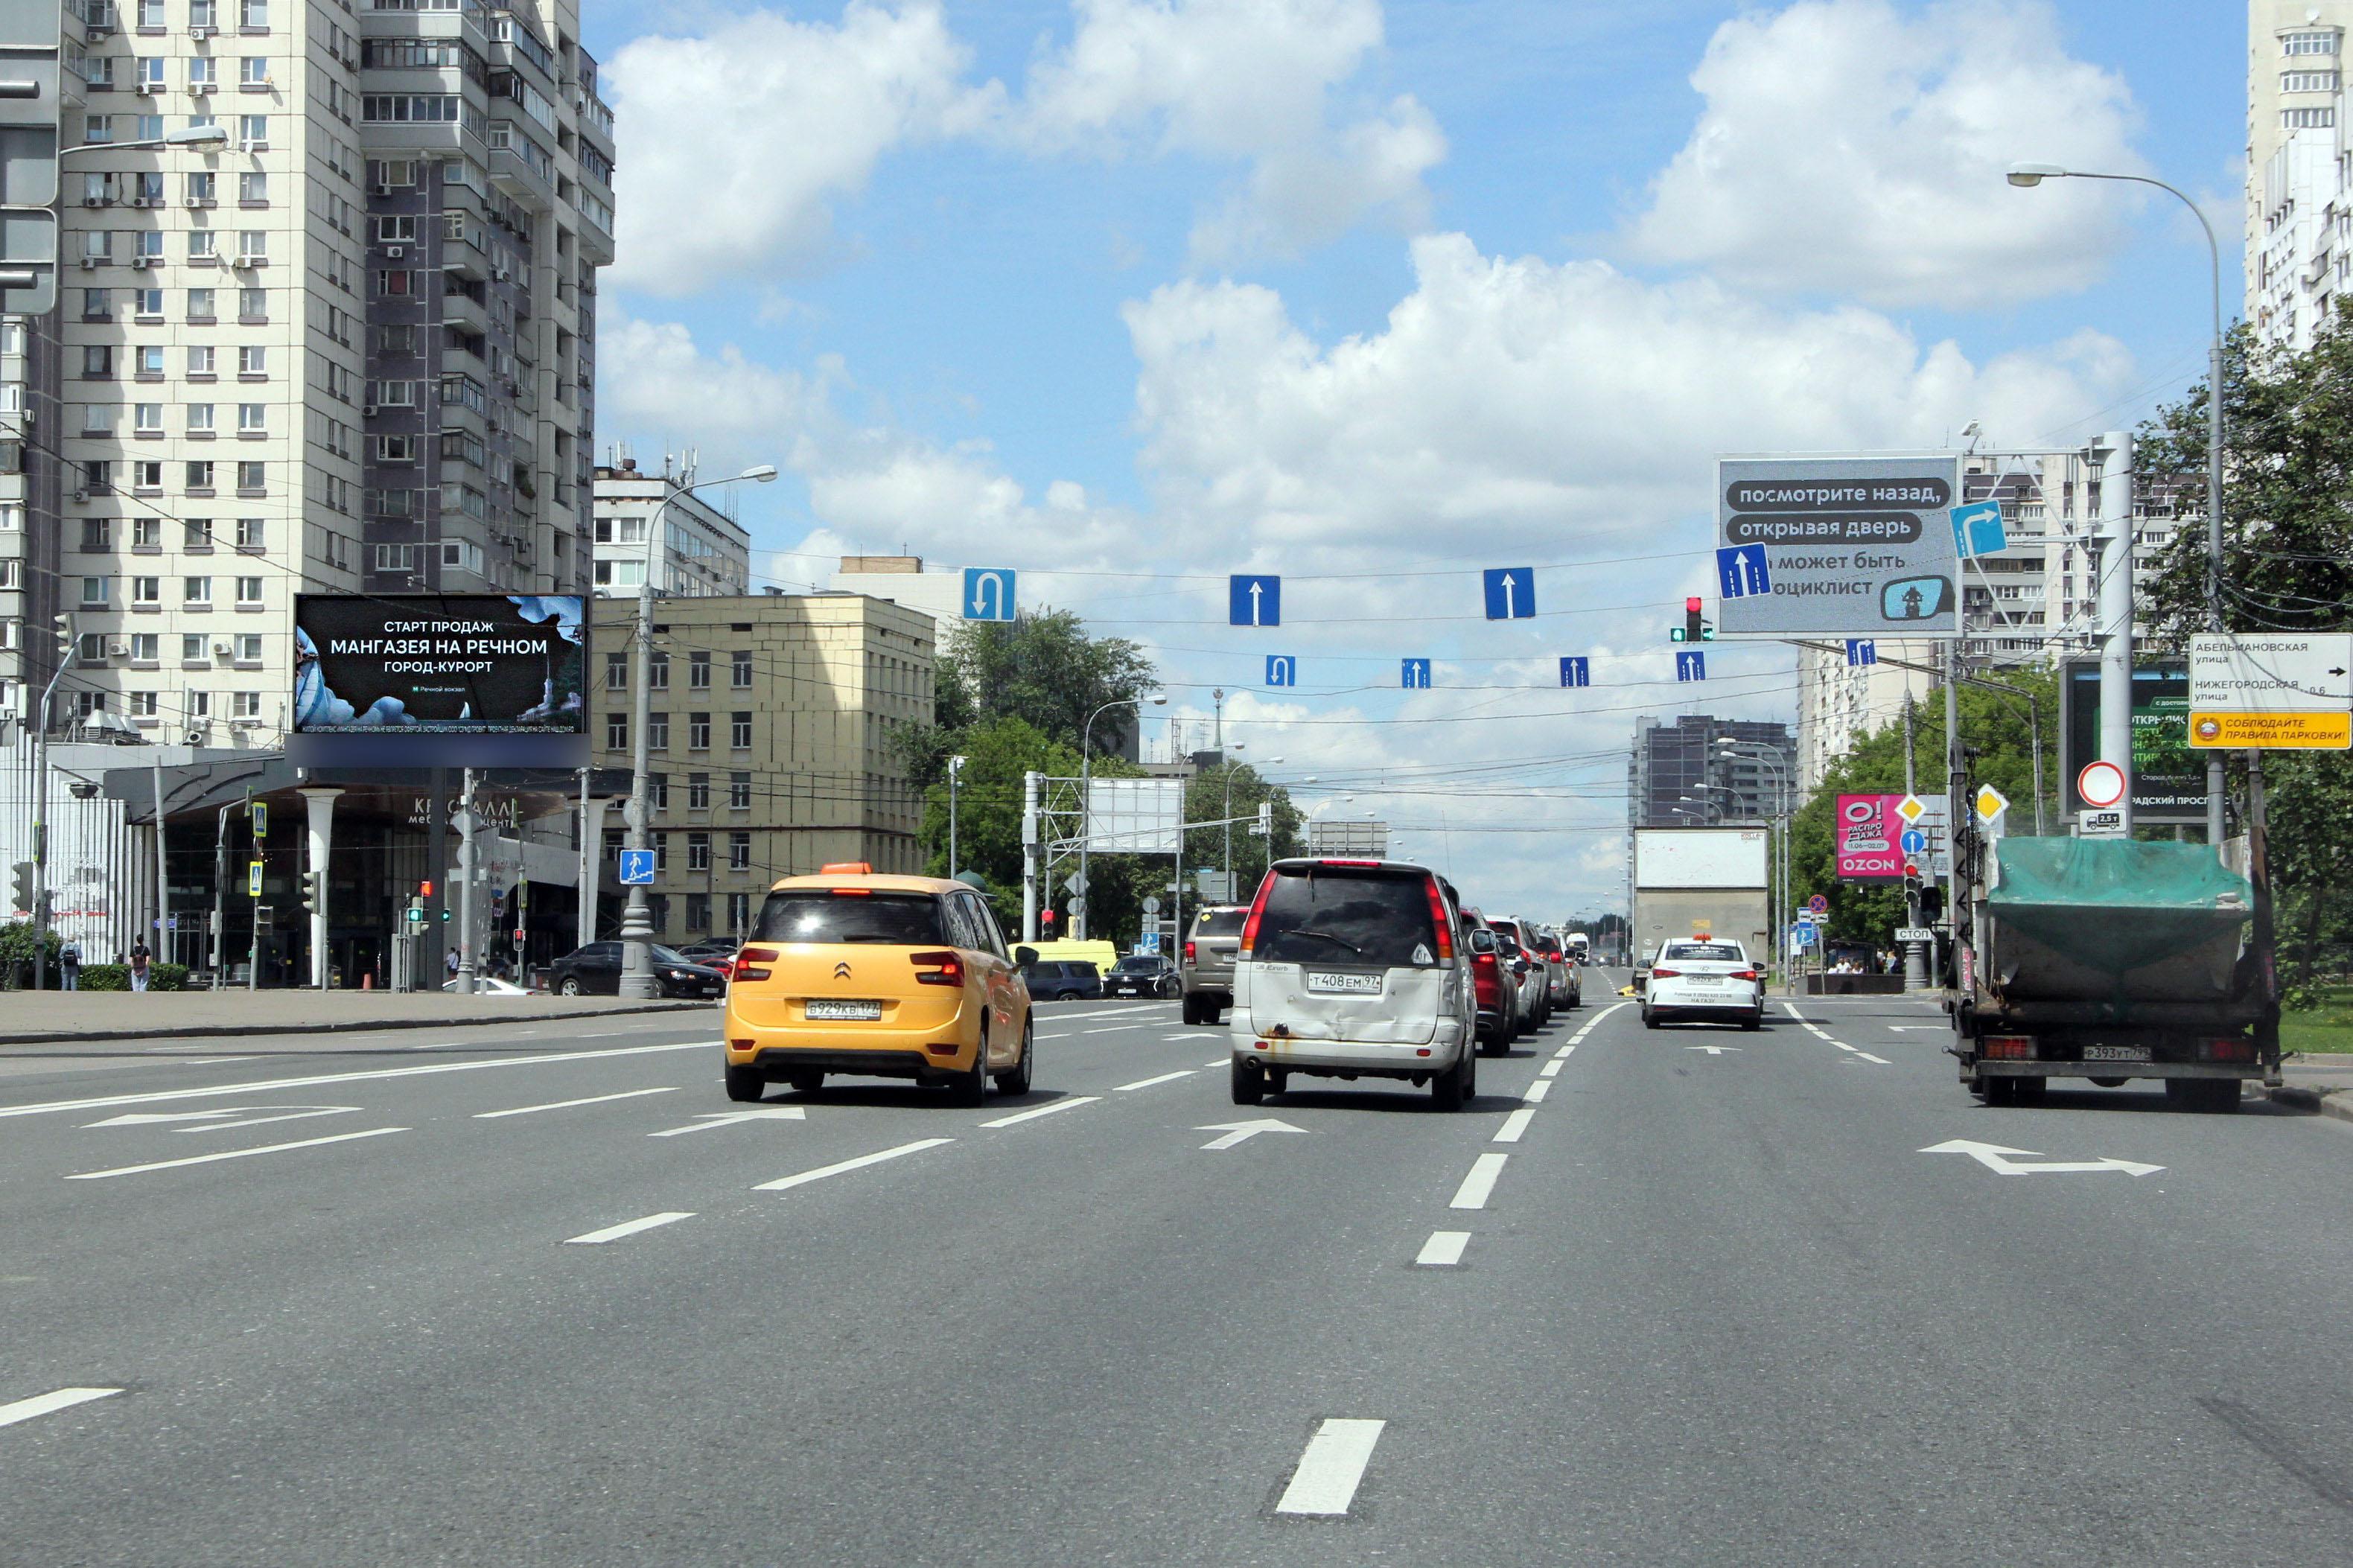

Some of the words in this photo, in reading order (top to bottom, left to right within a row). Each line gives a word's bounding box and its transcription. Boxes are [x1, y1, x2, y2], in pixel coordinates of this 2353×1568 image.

[1740, 488, 1867, 505] посмотрите
[1873, 486, 1941, 504] назад,
[1739, 521, 1840, 538] открывая
[1845, 520, 1911, 538] дверь
[1778, 556, 1847, 570] может
[1854, 552, 1905, 568] быть
[1773, 581, 1873, 598] оциклист
[384, 621, 427, 633] СТАРТ
[431, 621, 494, 634] ПРОДАЖ
[331, 640, 430, 654] МАНГАЗЕЯ
[436, 640, 461, 654] НА
[467, 640, 547, 654] РЕЧНОМ
[2195, 643, 2308, 652] АБЕЛЬМАНОВСКАЯ
[2195, 656, 2229, 665] улица
[384, 661, 493, 674] ГОРОД-КУРОРТ
[2195, 681, 2299, 690] НИЖЕГОРОДСКАЯ
[2195, 692, 2228, 701] улица
[2226, 718, 2305, 728] СОБЛЮДАЙТЕ
[2225, 730, 2279, 740] ПРАВИЛА
[2281, 730, 2346, 740] ПАРКОВКИ!
[1847, 823, 1883, 832] РАСПРО
[1843, 858, 1895, 871] OZON
[1900, 930, 1929, 939] СТОП
[1314, 975, 1361, 988] Т408ЕМ
[1364, 976, 1377, 986] 97
[809, 1002, 856, 1015] В929КВ
[859, 1001, 878, 1012] 177
[2087, 1048, 2130, 1058] Р393УТ
